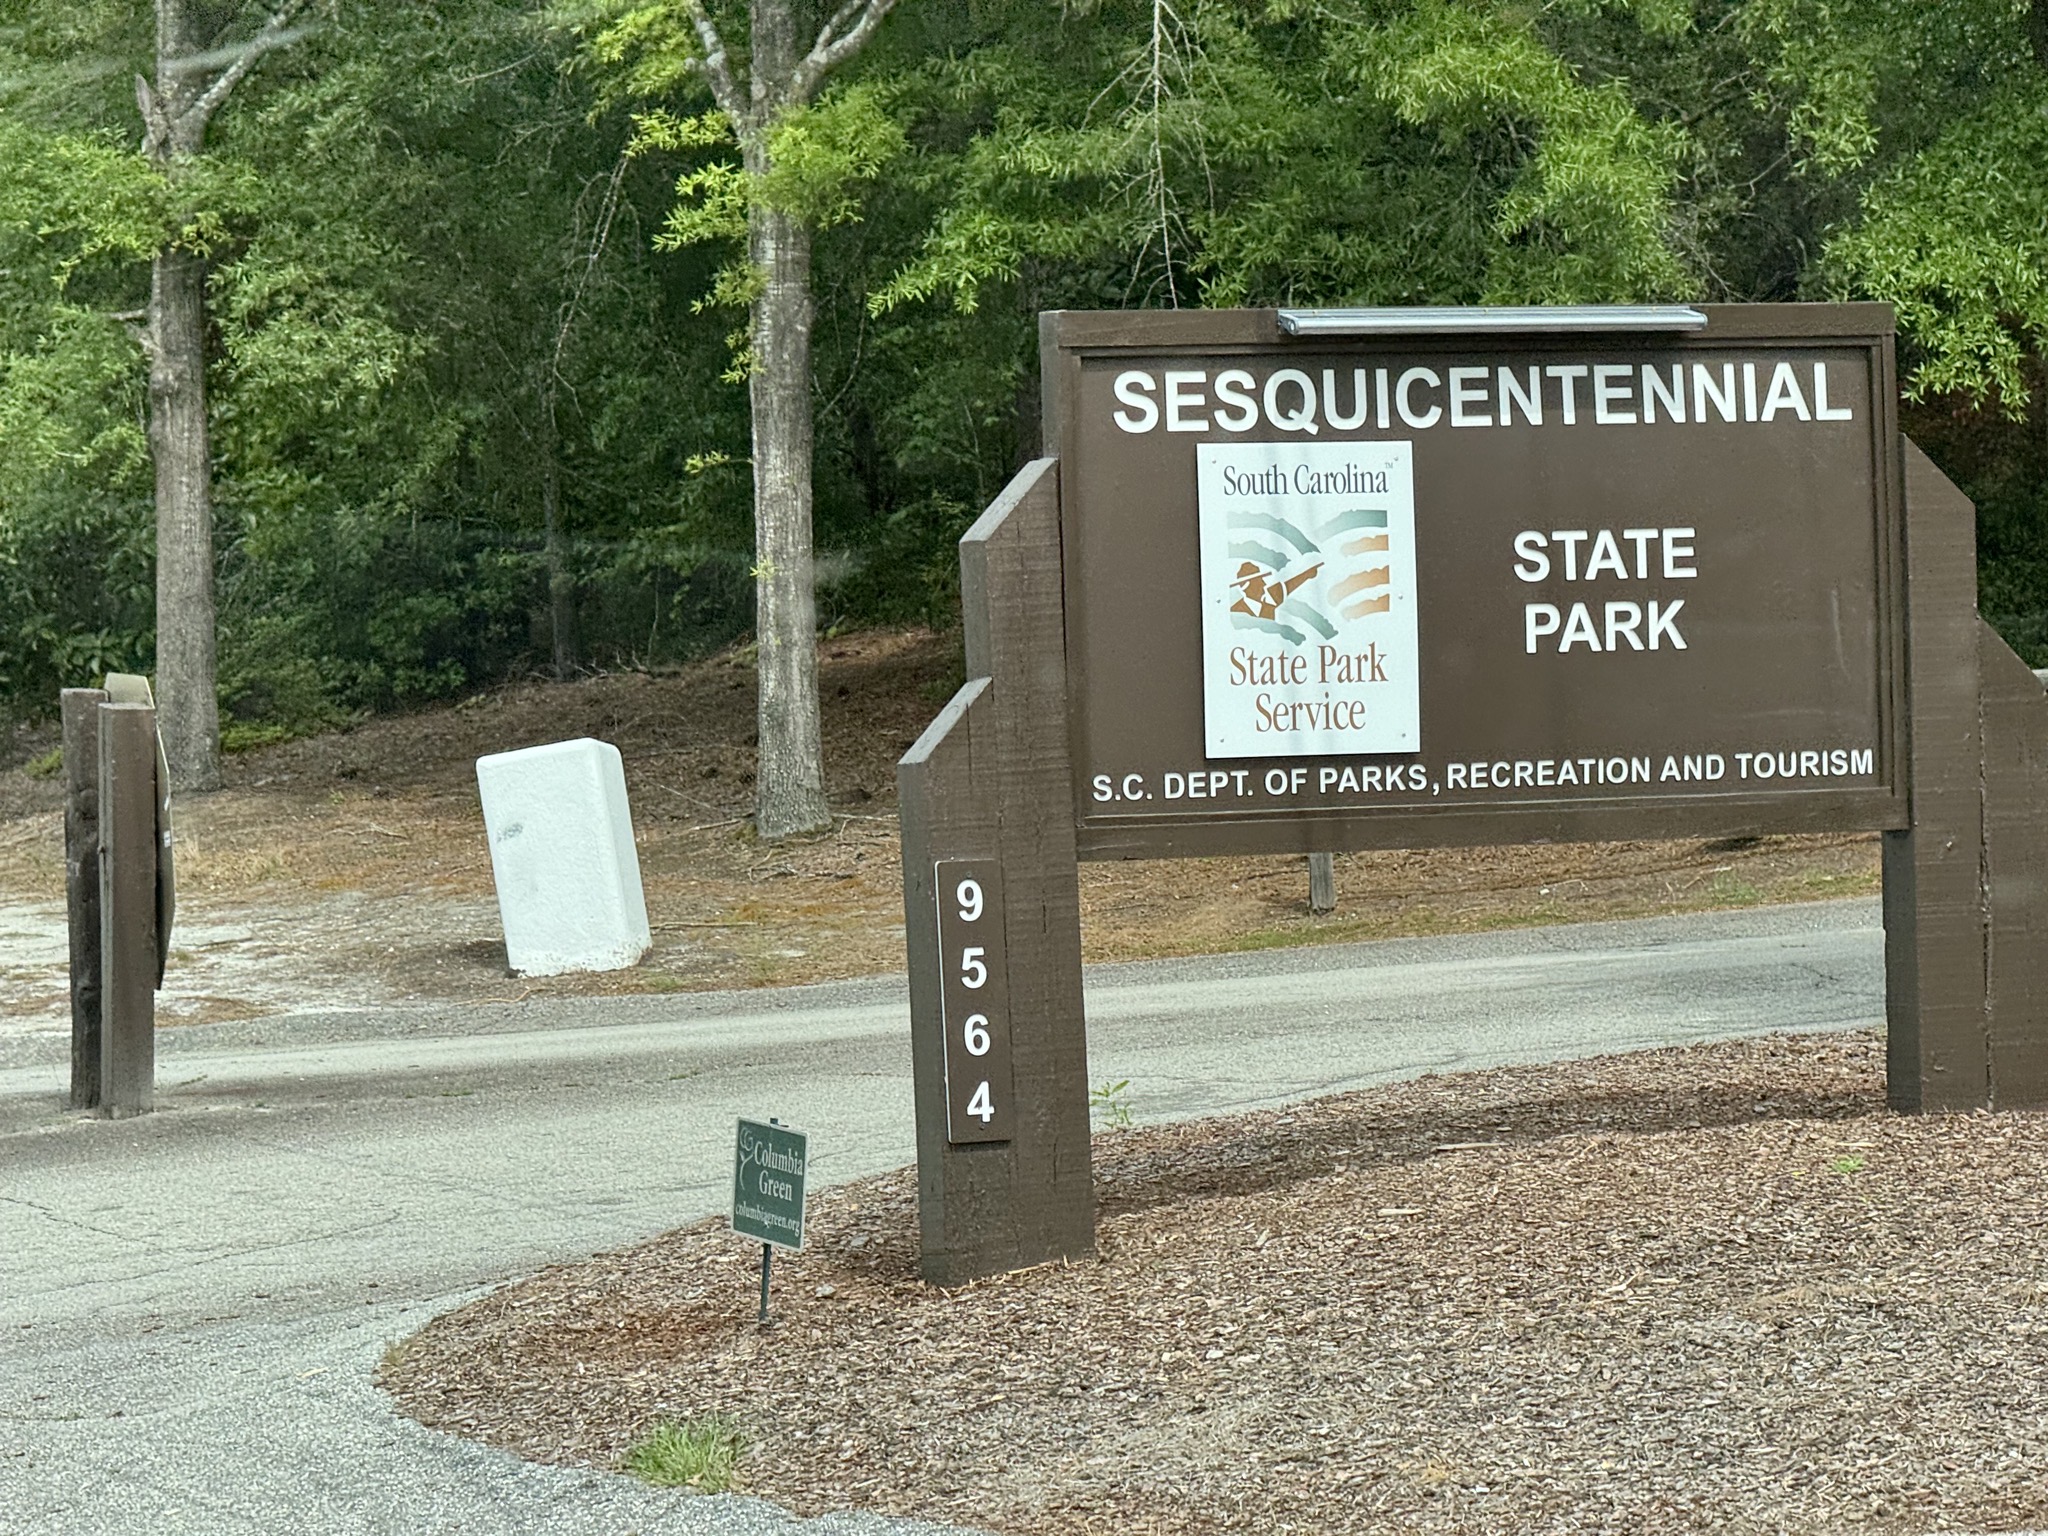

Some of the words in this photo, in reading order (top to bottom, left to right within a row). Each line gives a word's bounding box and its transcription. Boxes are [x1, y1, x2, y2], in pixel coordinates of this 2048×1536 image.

[1112, 361, 1854, 436] SESQUICENTENNIAL
[1223, 463, 1290, 496] South
[1293, 462, 1389, 495] Carolina
[1512, 527, 1698, 583] STATE
[1524, 599, 1688, 654] PARK
[1230, 646, 1308, 686] State
[1317, 641, 1389, 684] Park
[1255, 691, 1367, 733] Service
[1092, 774, 1153, 801] S.C.
[1163, 769, 1254, 799] DEPT.
[1264, 767, 1308, 796] OF
[1319, 763, 1441, 797] PARKS,
[1446, 756, 1651, 790] RECREATION
[1659, 754, 1726, 782] AND
[1734, 748, 1875, 780] TOURISM
[754, 1141, 803, 1176] Columbia
[758, 1169, 793, 1201] Green
[735, 1200, 801, 1237] columbiagreen.org
